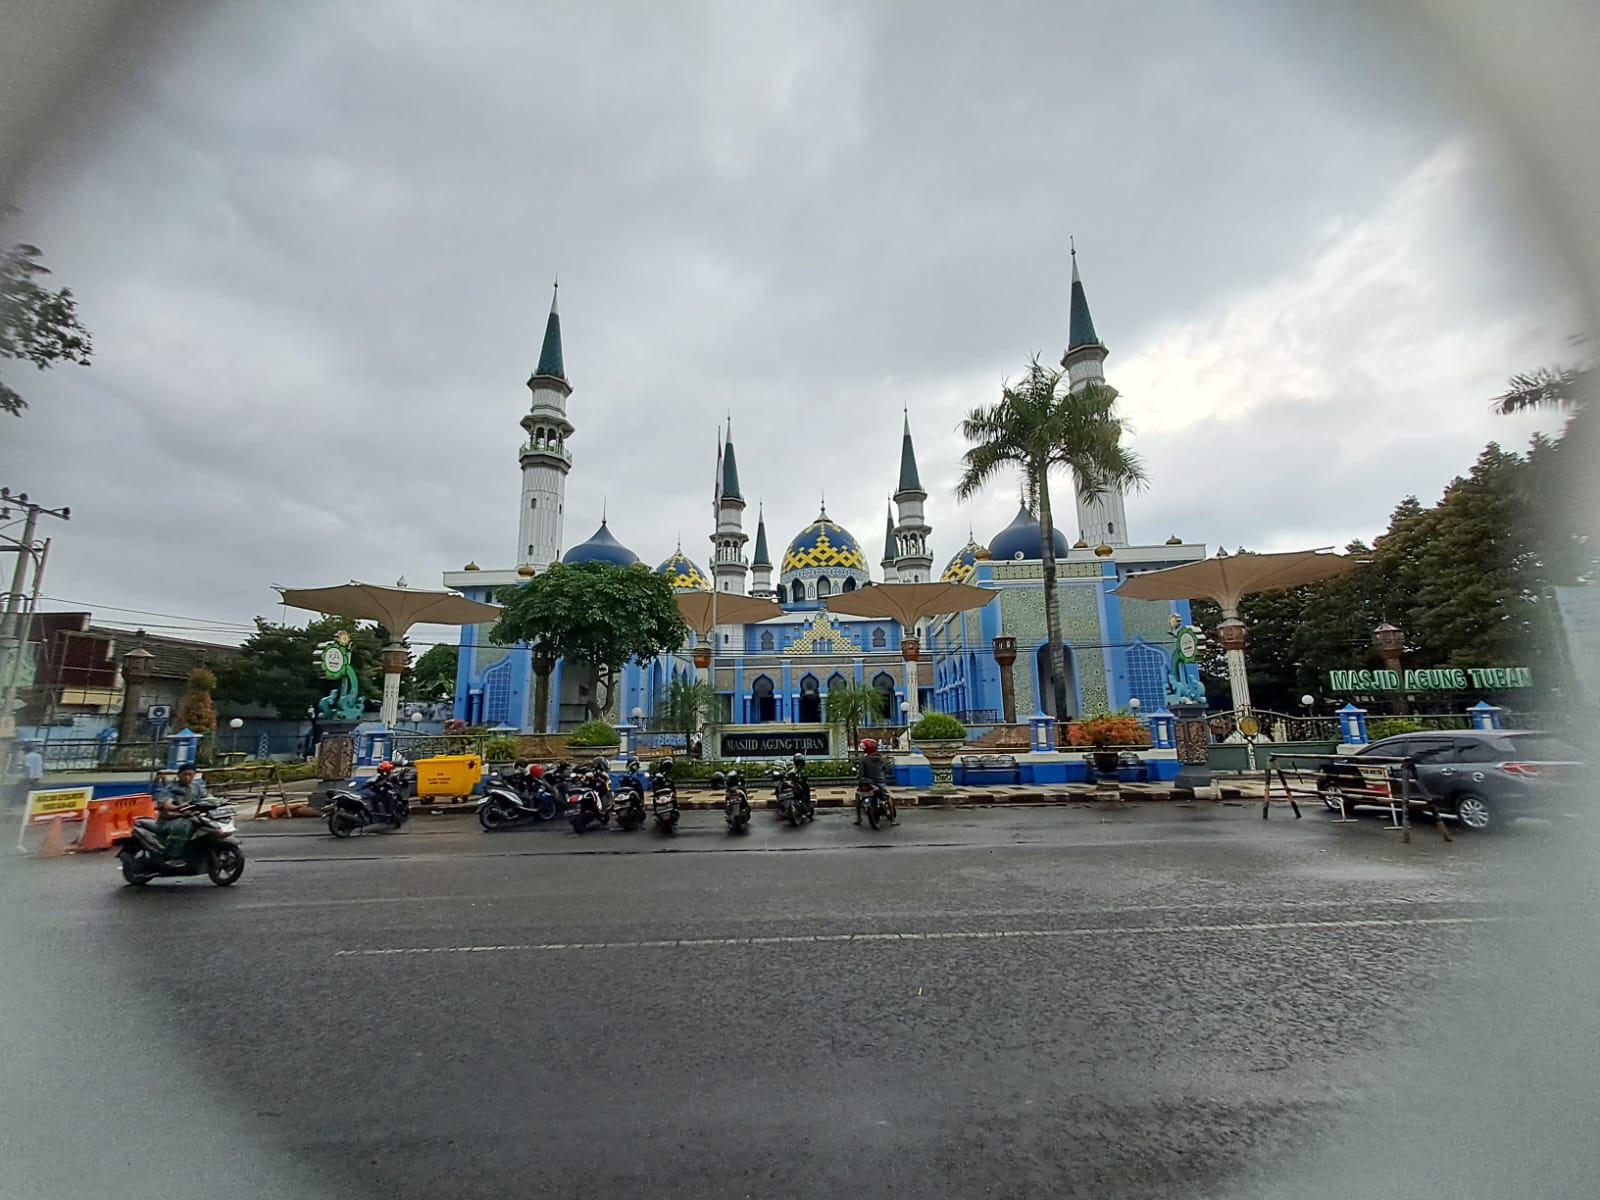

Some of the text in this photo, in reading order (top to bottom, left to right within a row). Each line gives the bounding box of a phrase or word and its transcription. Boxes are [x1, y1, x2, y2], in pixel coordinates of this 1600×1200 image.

[1330, 667, 1531, 690] MASJID AGUNG TUBAN
[727, 738, 824, 751] MASJID AGUNG TUBAN
